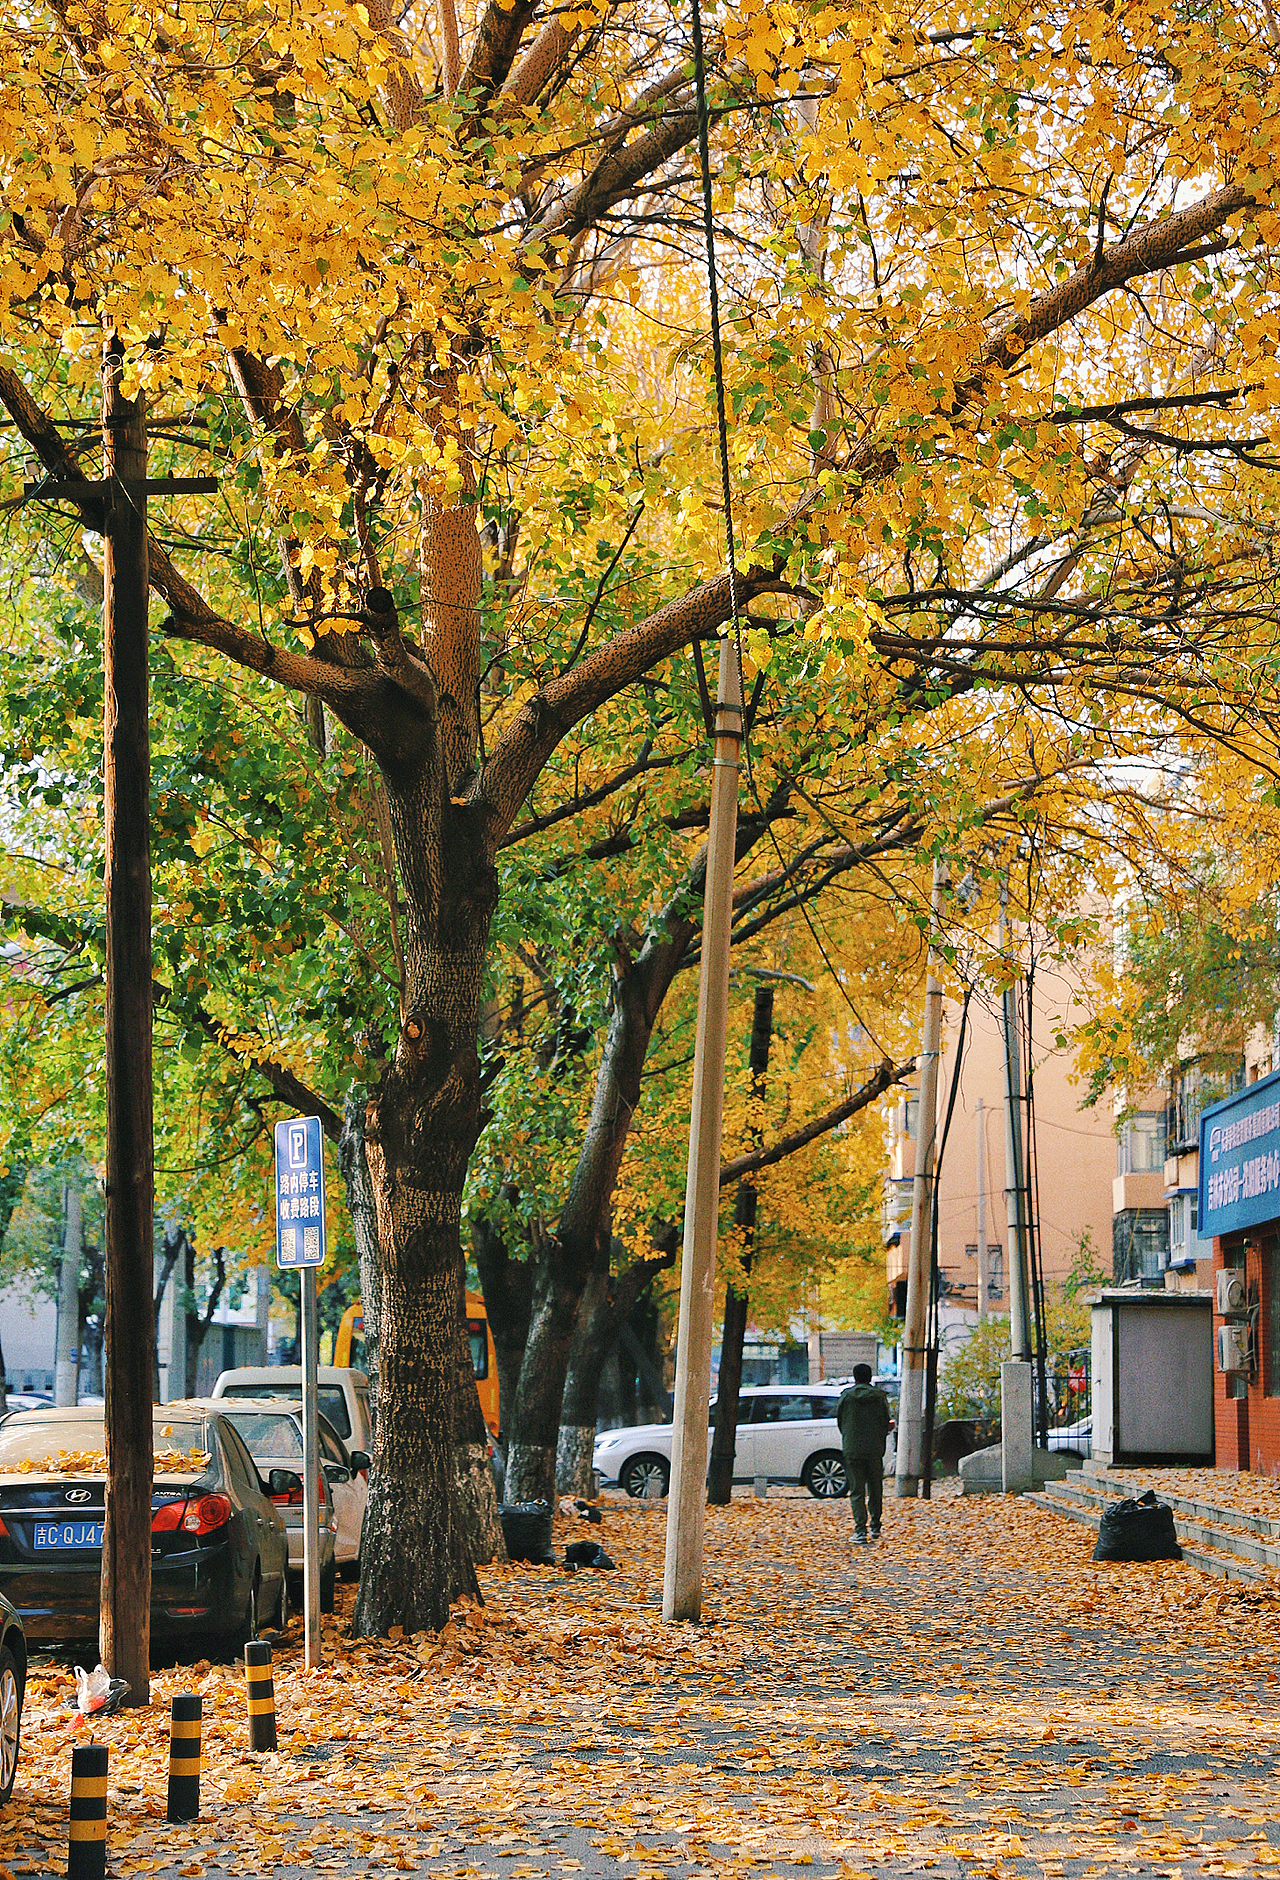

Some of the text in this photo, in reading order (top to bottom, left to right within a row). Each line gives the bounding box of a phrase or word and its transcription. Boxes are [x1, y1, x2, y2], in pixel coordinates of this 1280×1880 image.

[292, 1132, 304, 1161] P
[279, 1170, 319, 1195] 路内停车
[280, 1195, 320, 1221] 收费路段
